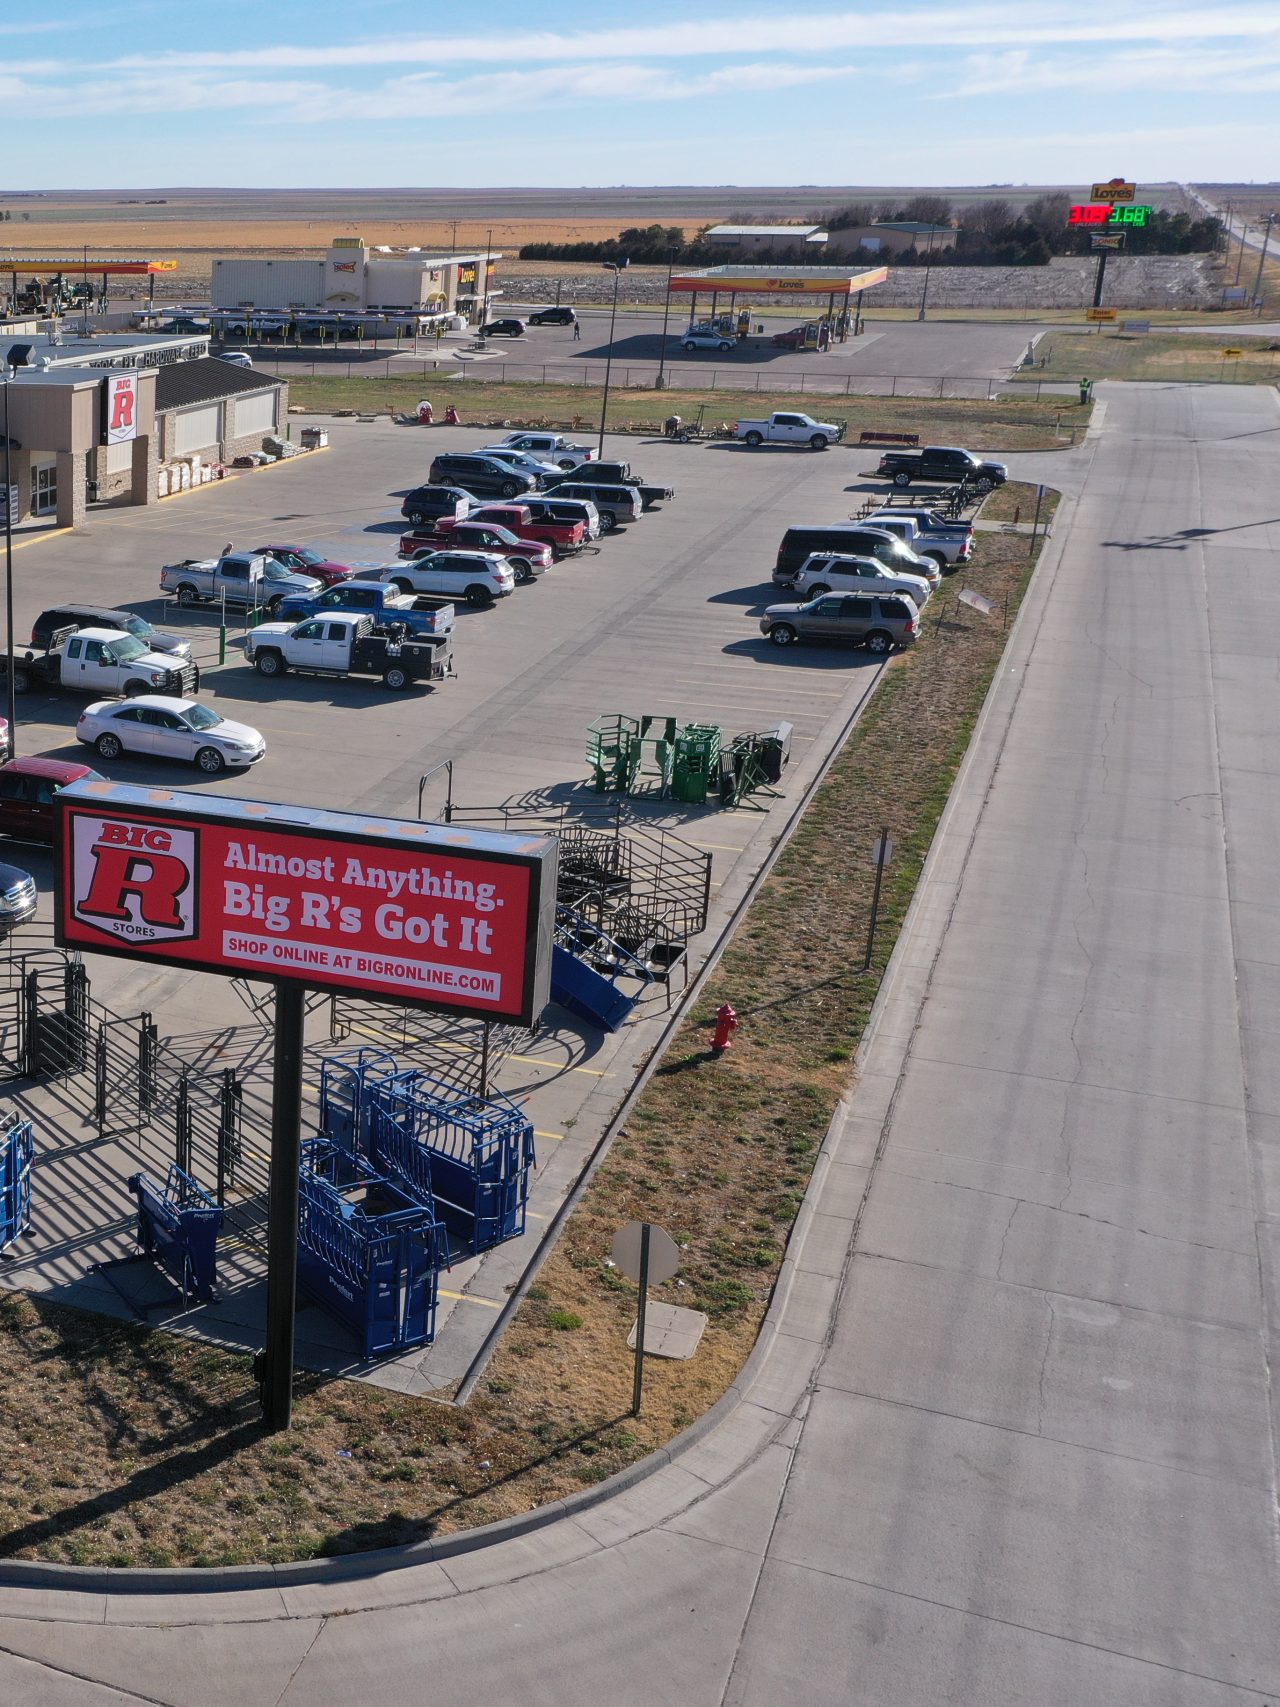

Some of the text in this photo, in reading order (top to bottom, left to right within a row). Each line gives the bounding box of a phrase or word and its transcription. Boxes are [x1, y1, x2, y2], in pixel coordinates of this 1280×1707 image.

[1093, 187, 1132, 199] Love's
[779, 280, 805, 289] Love's
[122, 355, 138, 368] PET
[116, 379, 131, 390] BIG
[111, 391, 134, 429] R
[97, 822, 173, 852] BIG
[77, 844, 191, 931] R
[223, 841, 505, 913] Almost Anything.
[112, 922, 156, 938] STORES
[223, 880, 494, 955] Big R's Got It
[228, 936, 495, 993] SHOP ONLINE AT BIGRONLINE.COM
